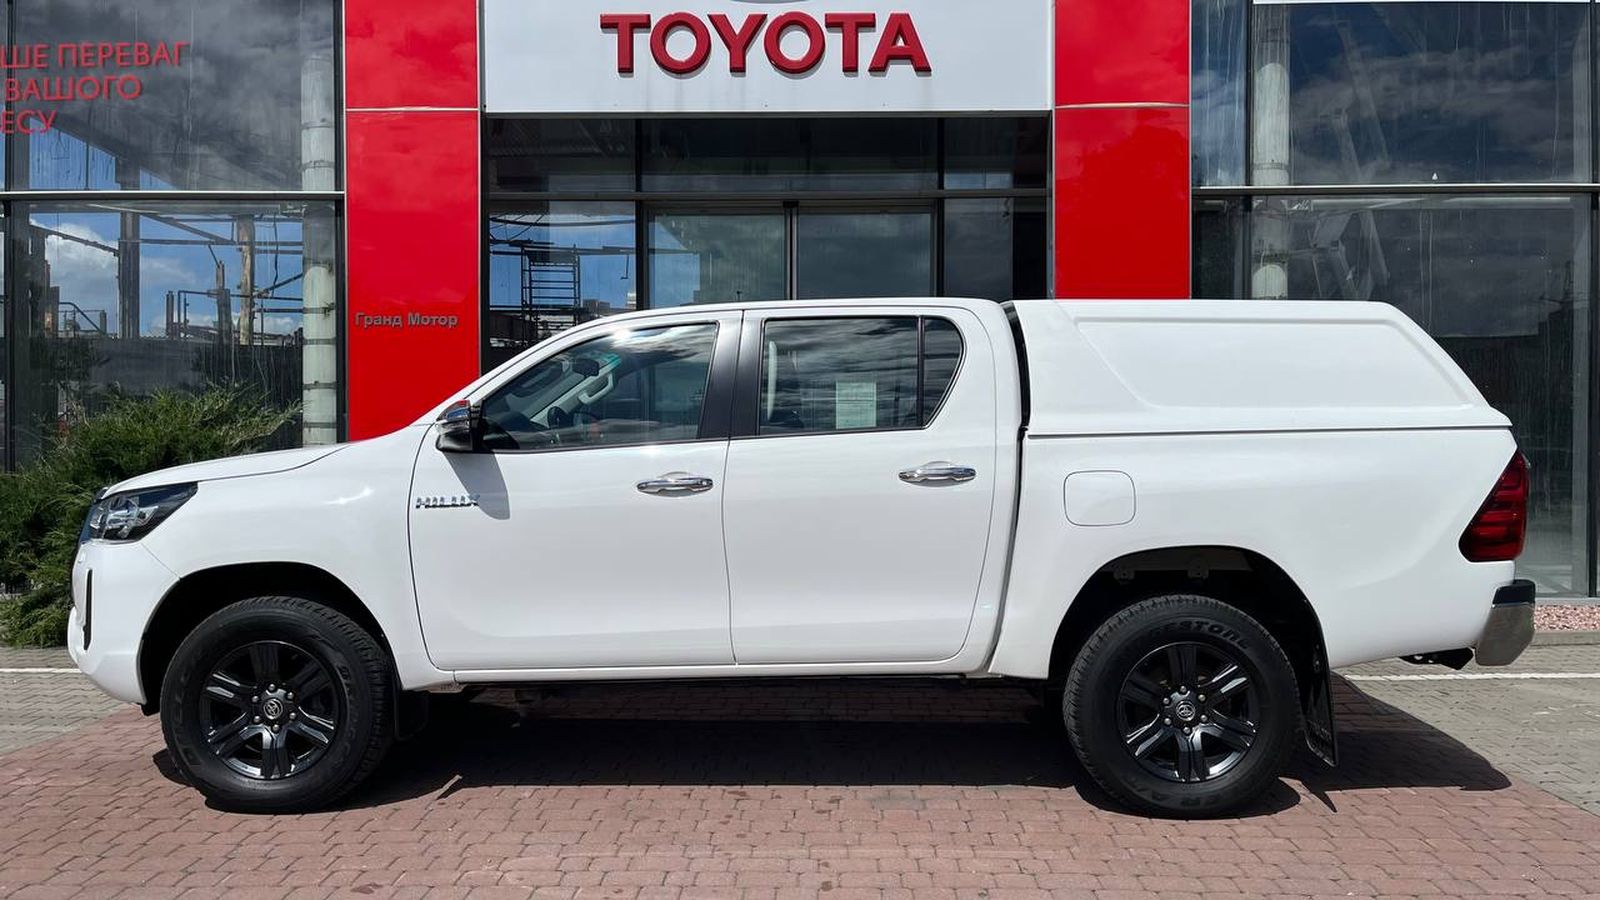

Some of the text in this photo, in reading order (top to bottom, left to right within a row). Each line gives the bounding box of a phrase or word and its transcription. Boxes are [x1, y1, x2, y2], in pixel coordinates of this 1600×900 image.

[58, 40, 191, 68] ПЕРЕВАГ
[600, 12, 932, 75] TOYOTA
[5, 74, 143, 101] ВАШОГО
[1, 109, 57, 135] ЕСУ
[355, 312, 459, 328] Гранд Мотор
